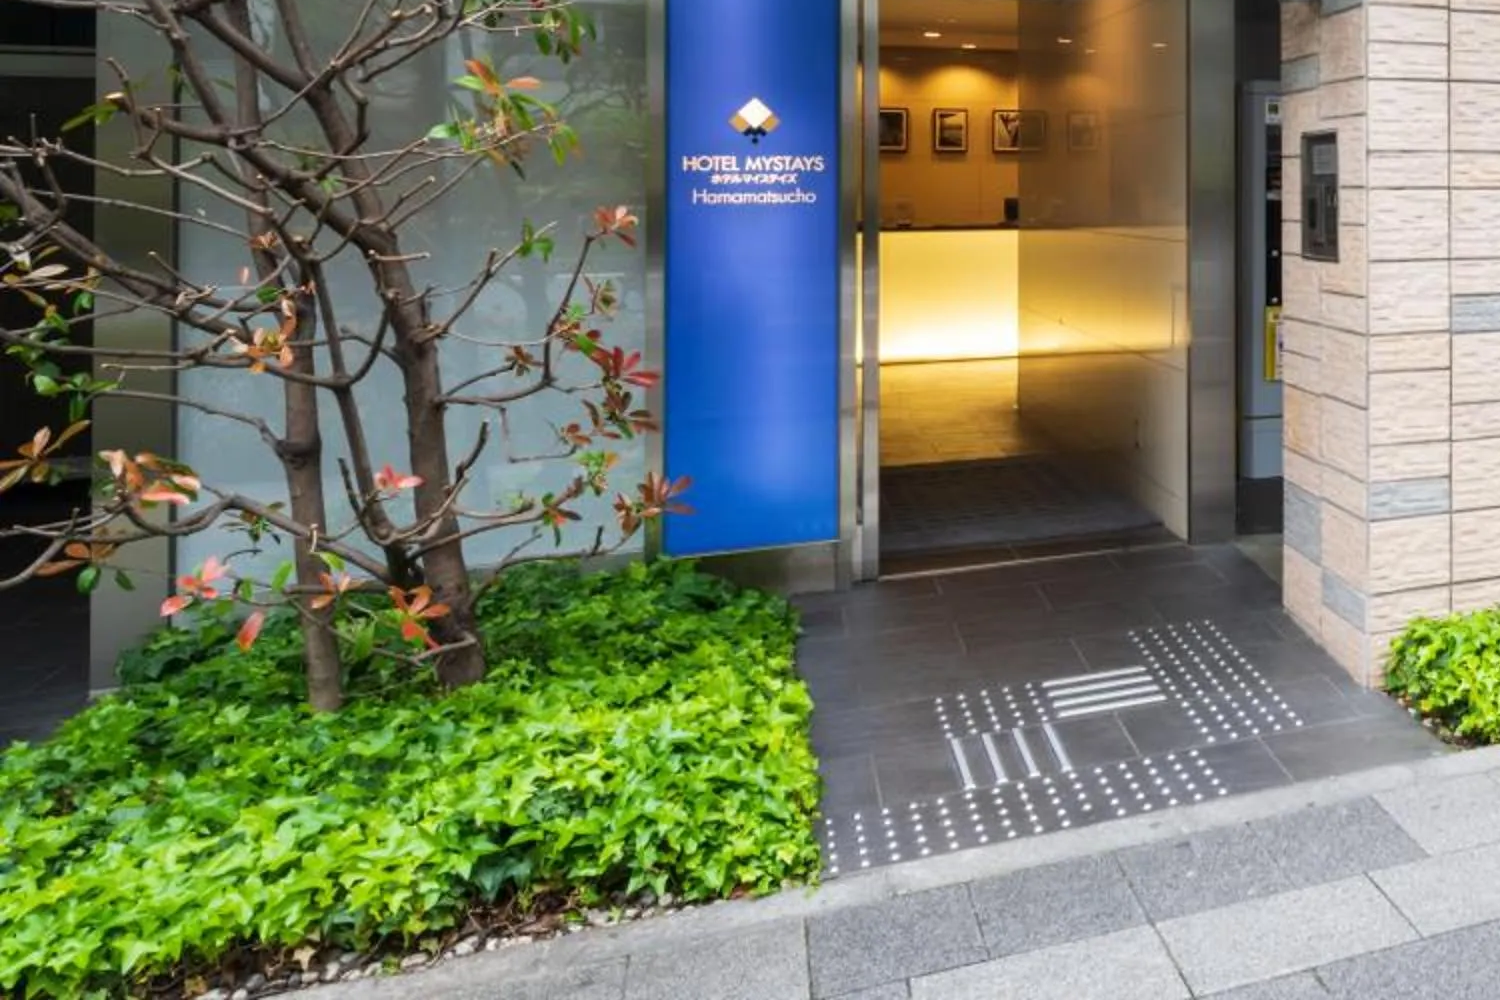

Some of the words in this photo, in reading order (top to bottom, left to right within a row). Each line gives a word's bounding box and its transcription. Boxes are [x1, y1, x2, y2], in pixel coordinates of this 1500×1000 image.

[682, 155, 740, 172] HOTEL
[745, 155, 825, 172] MYSTAYS
[692, 188, 817, 205] Hamamatsucho
